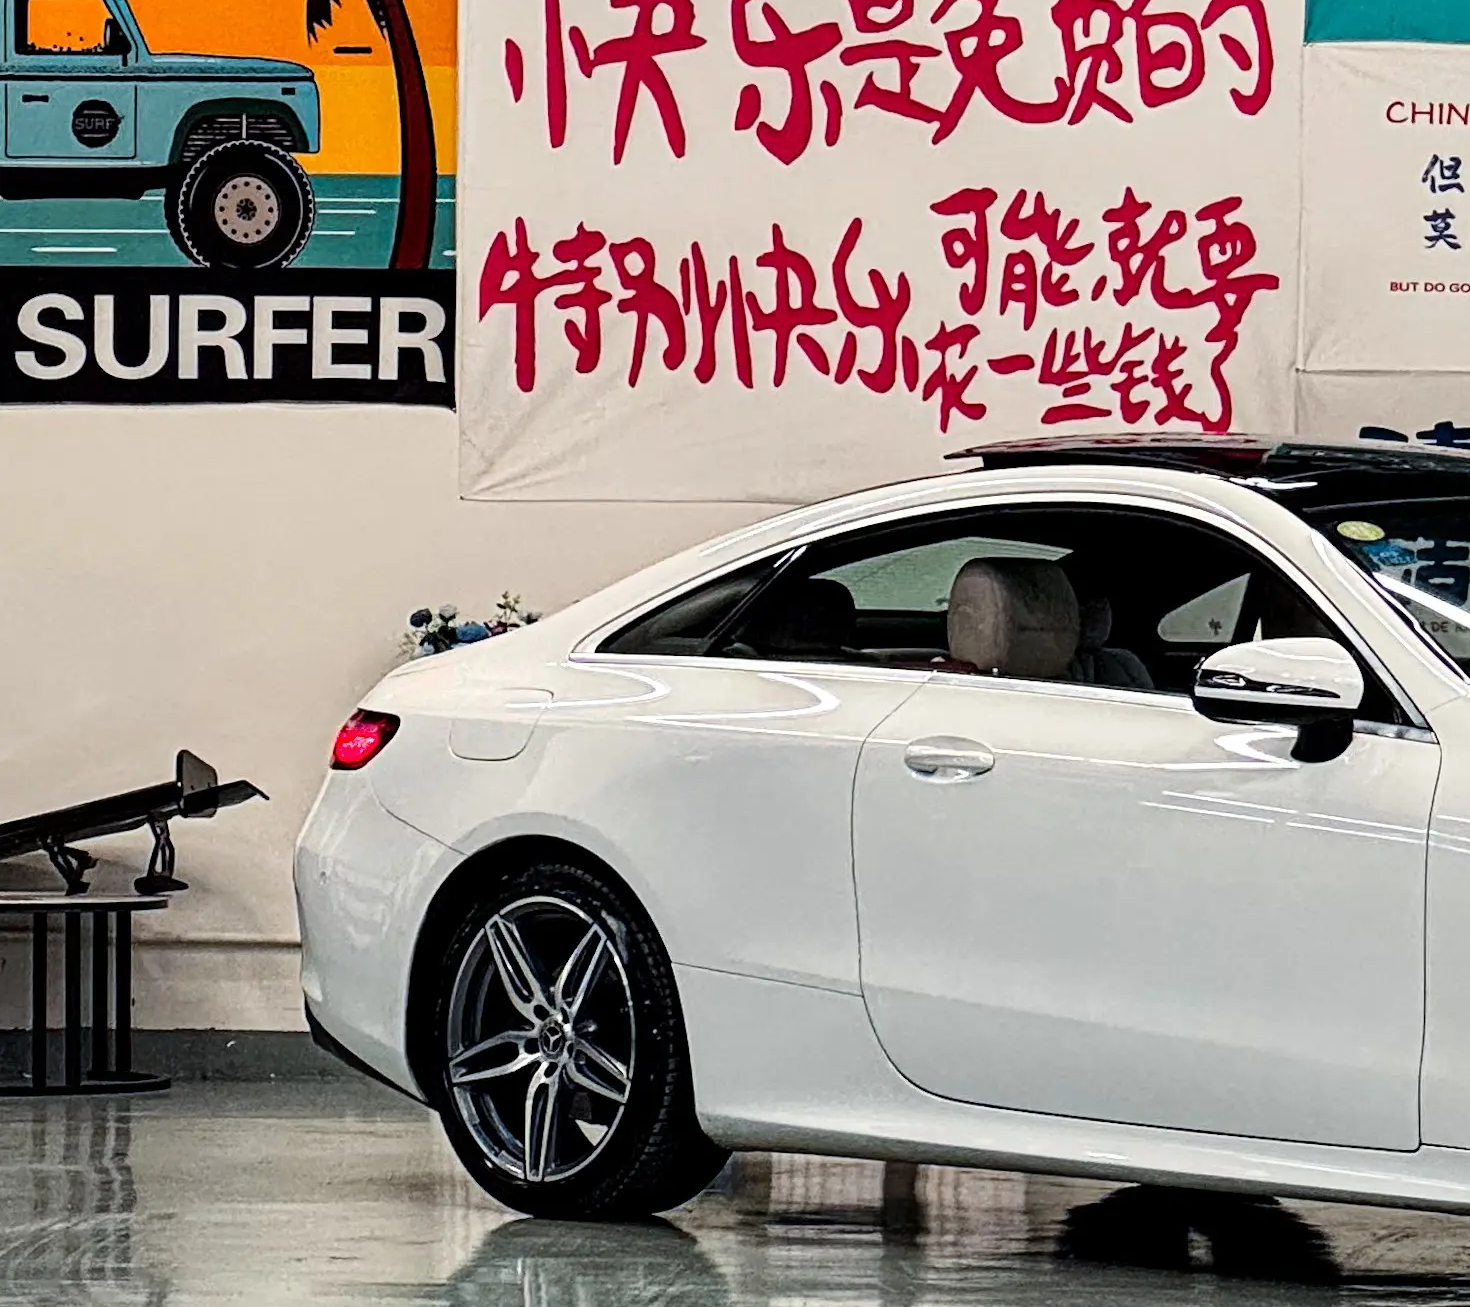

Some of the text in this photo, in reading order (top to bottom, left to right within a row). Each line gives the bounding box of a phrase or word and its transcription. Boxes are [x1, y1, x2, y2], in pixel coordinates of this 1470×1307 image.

[478, 217, 918, 392] 特别快乐
[1390, 282, 1419, 292] BUT
[1424, 283, 1446, 293] DO
[14, 293, 447, 383] SURFER
